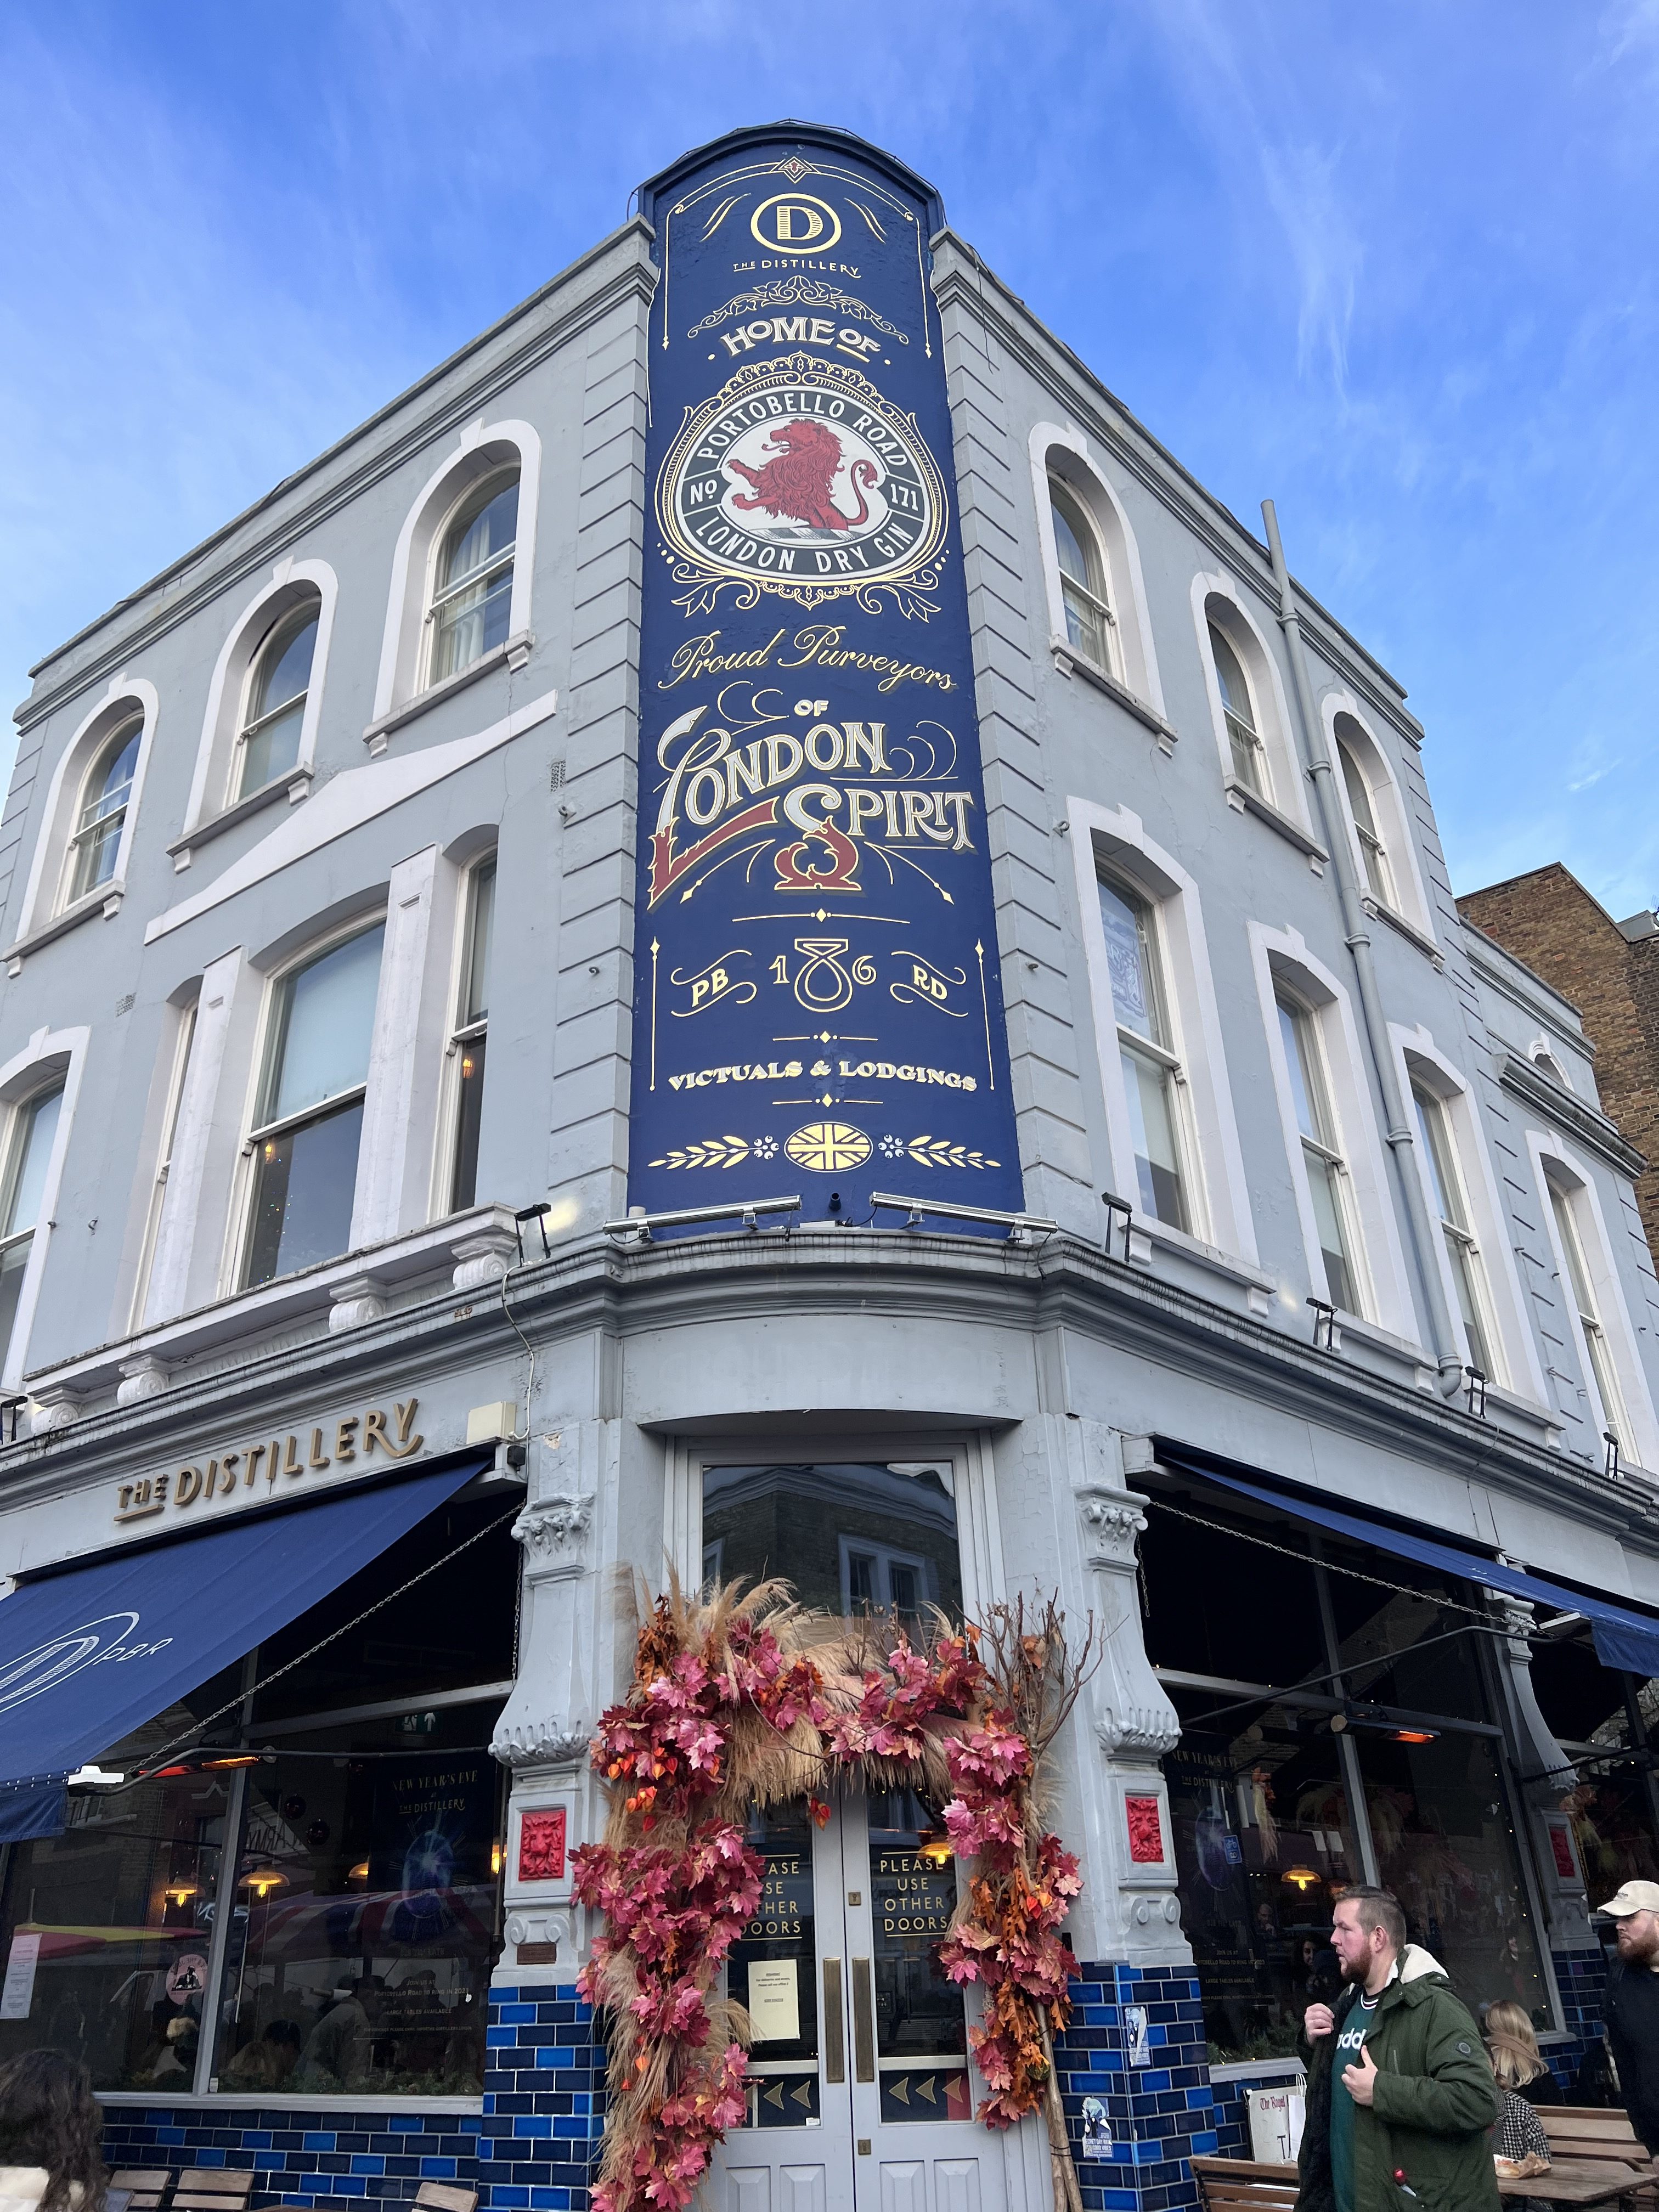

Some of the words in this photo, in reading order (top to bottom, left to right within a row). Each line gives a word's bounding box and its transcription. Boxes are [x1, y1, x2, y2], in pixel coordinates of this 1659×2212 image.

[776, 206, 823, 240] D
[733, 261, 755, 272] THE
[761, 259, 861, 279] DISTILLERY
[720, 317, 836, 357] HOME
[837, 328, 882, 353] OF
[697, 393, 845, 459] PORTOBELLO
[853, 411, 907, 467] ROAD
[890, 483, 918, 511] 171
[696, 515, 795, 572] LONDON
[815, 549, 871, 573] DRY
[877, 521, 914, 558] GIN
[657, 629, 786, 689] Proud
[777, 624, 957, 692] Purveyors
[794, 699, 829, 716] OF
[646, 705, 893, 911] LONDON
[774, 783, 975, 891] SPIRIT
[691, 968, 730, 1007] PB
[668, 1060, 803, 1091] VICTUALS
[810, 1060, 831, 1076] &
[839, 1060, 978, 1092] LODGINGS
[116, 1473, 168, 1514] THE
[173, 1397, 424, 1506] DISTILLERY
[419, 1773, 456, 1788] YEAR'S
[458, 1769, 478, 1784] EVE
[399, 1804, 412, 1813] THE
[414, 1798, 466, 1813] DISTILLERY
[768, 1861, 799, 1875] ASE
[765, 1881, 783, 1895] SE
[897, 1877, 929, 1892] USE
[764, 1900, 798, 1915] HER
[884, 1897, 944, 1911] OTHER
[884, 1916, 947, 1932] DOORS
[1260, 2097, 1270, 2111] The
